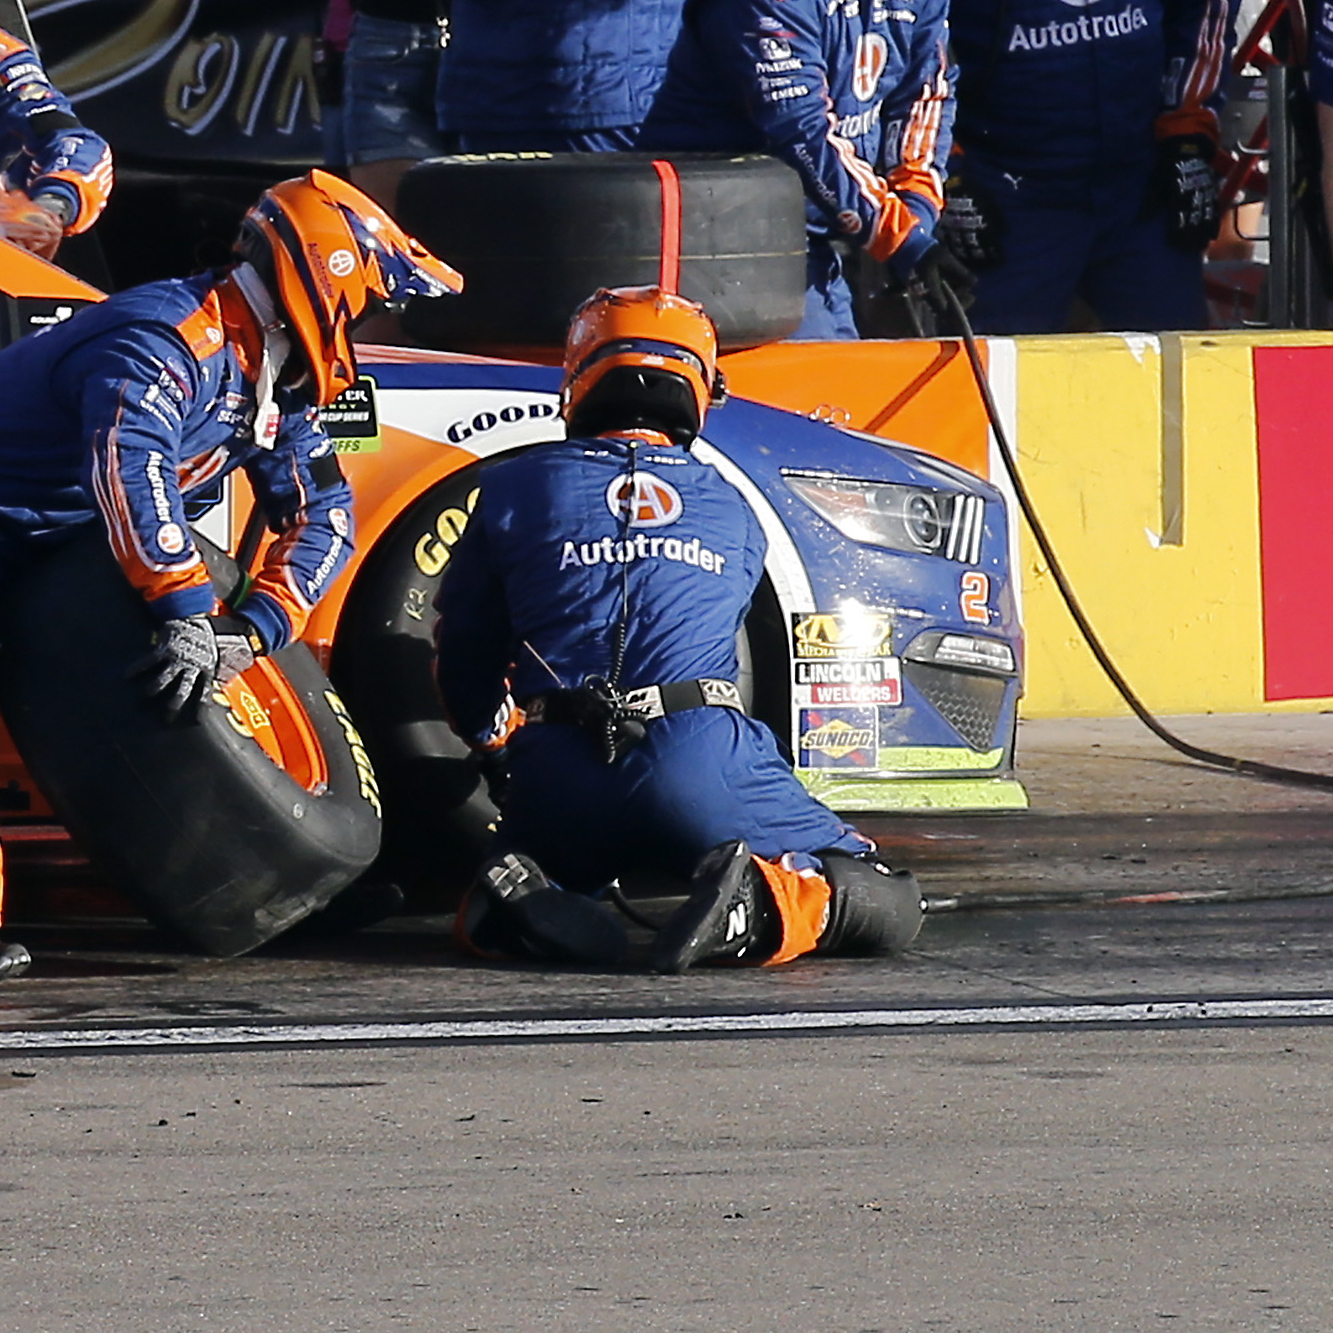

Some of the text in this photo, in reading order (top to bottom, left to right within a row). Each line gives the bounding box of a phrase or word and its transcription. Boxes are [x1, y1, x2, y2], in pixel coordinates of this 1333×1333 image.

[447, 403, 555, 443] GOOD
[559, 533, 727, 576] Autotrader
[960, 571, 992, 626] 2
[798, 663, 882, 684] LINCOLN
[817, 686, 892, 703] WELDERS
[806, 731, 872, 747] SUNOCO
